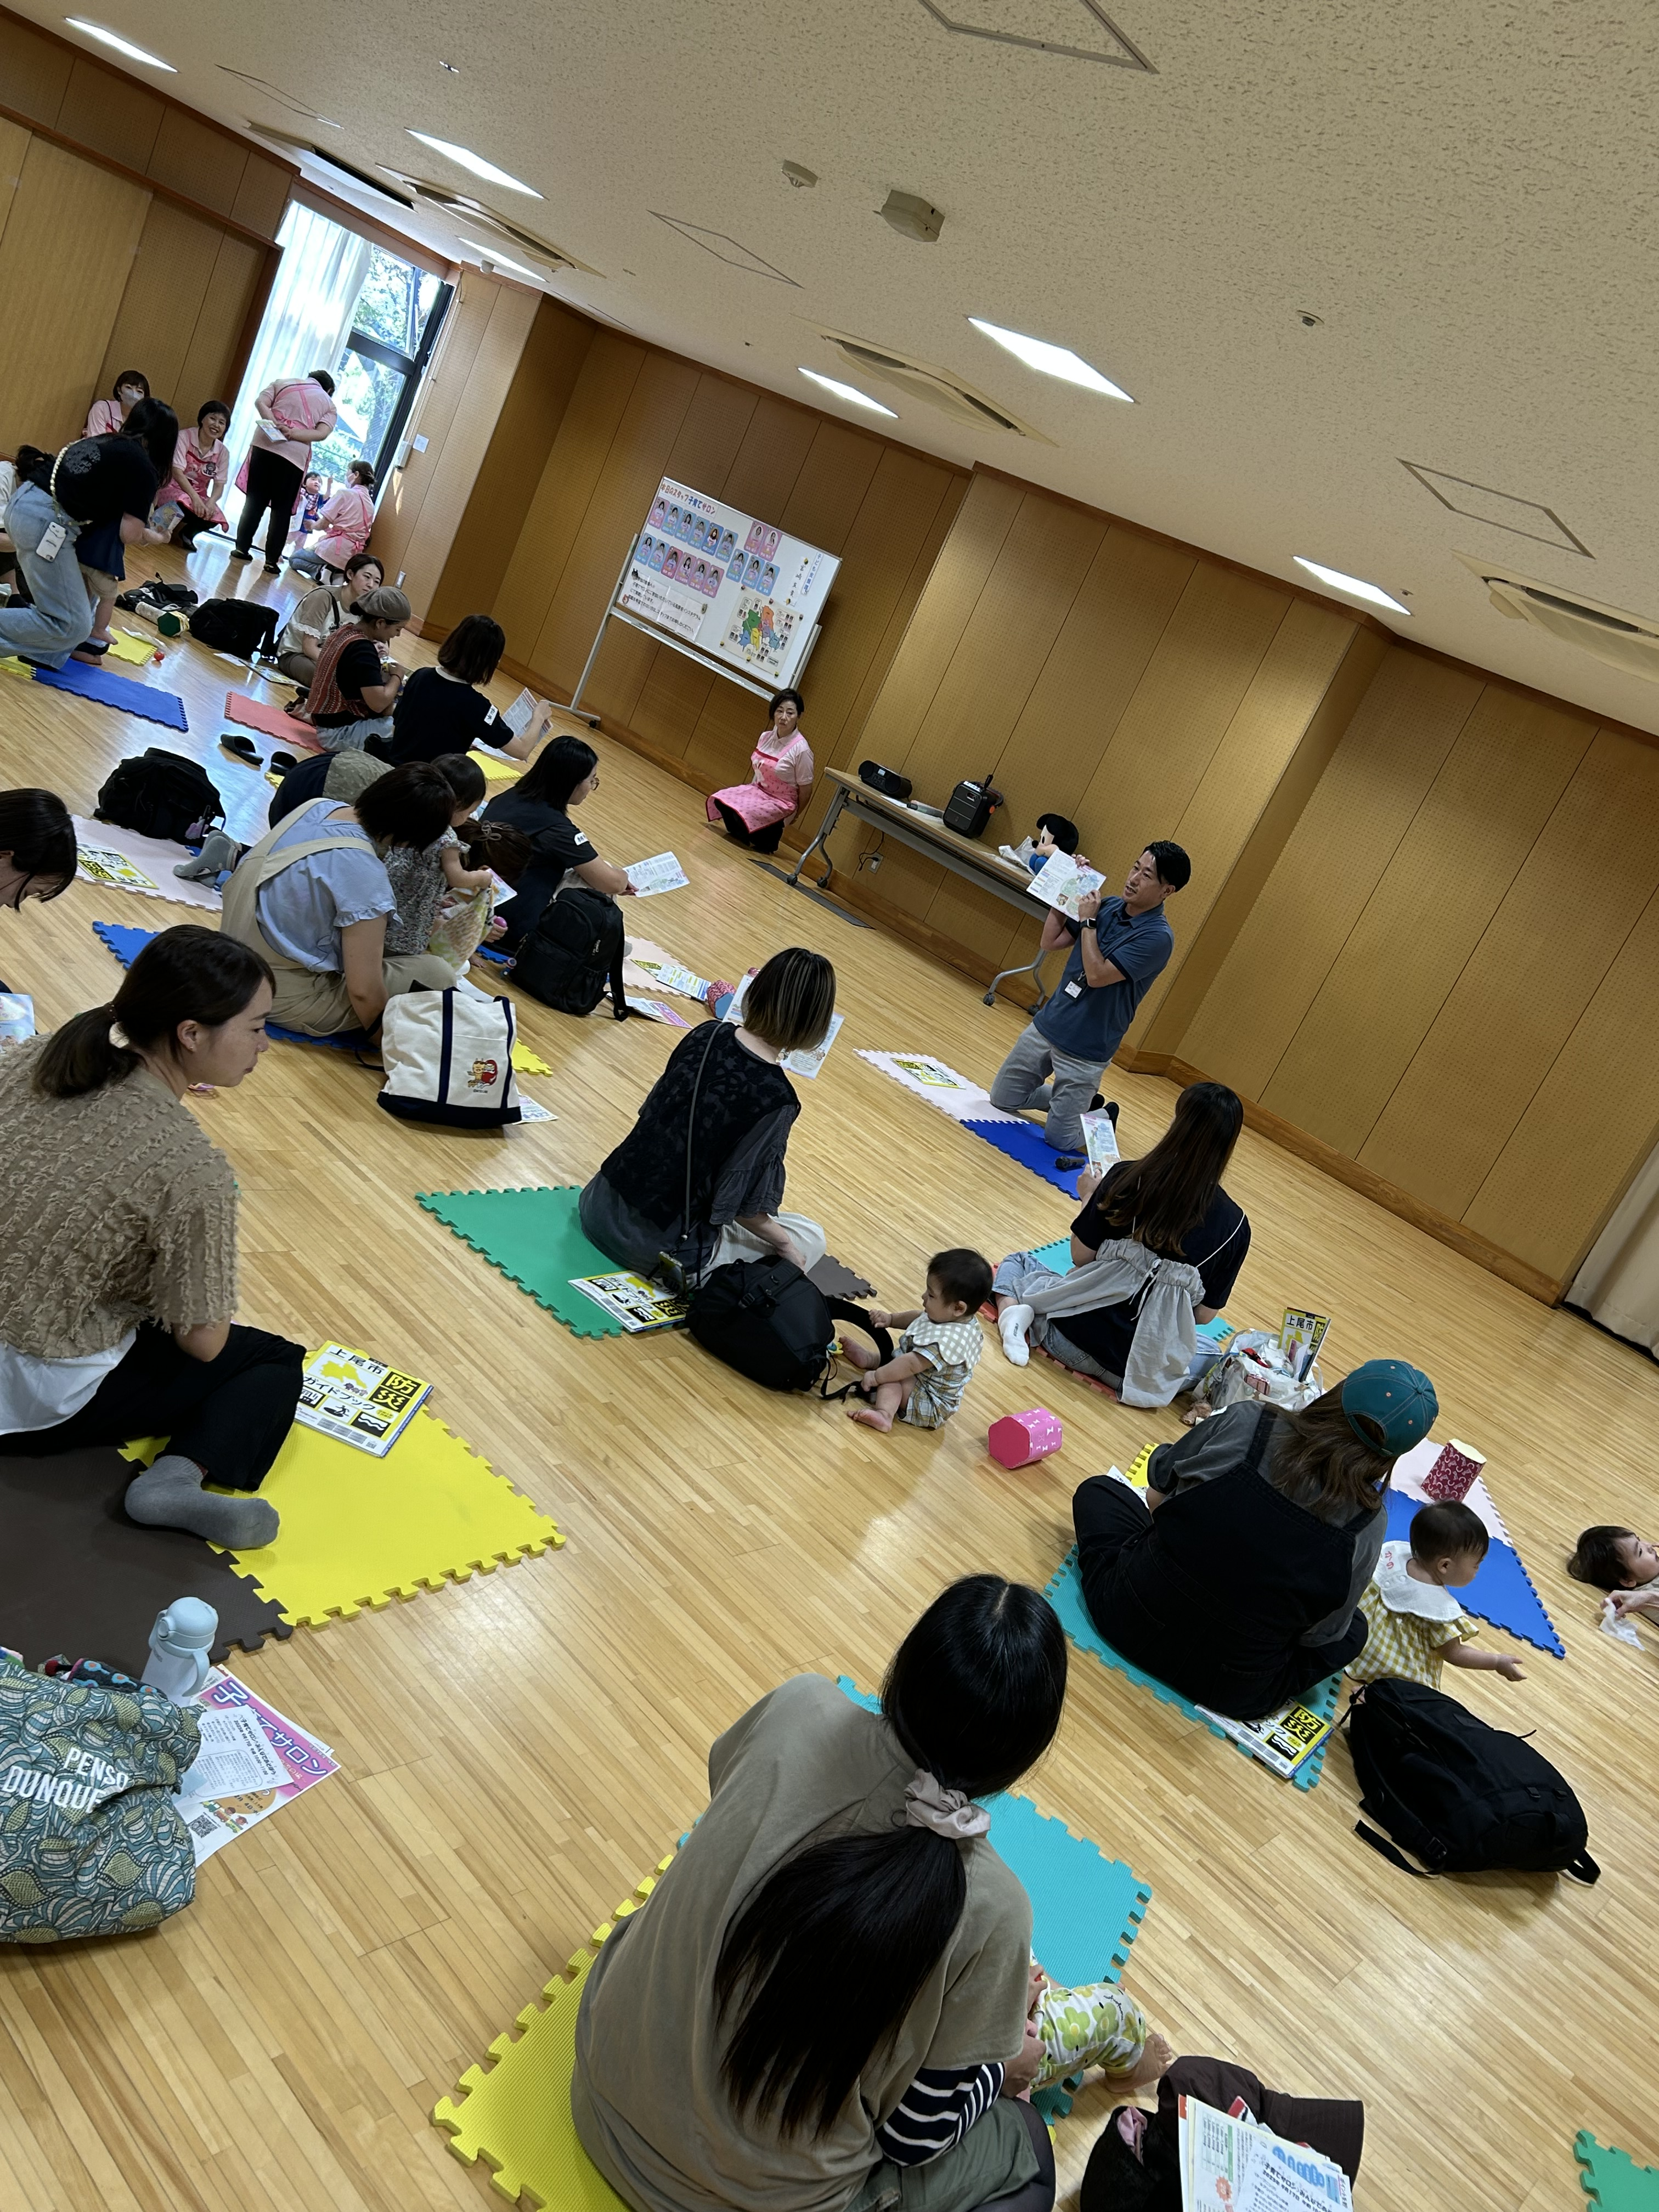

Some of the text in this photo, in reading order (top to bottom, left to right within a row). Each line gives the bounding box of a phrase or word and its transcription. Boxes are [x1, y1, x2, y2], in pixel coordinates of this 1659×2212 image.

[687, 496, 716, 515] 子育てサロン
[607, 1277, 653, 1308] ガイドブック
[1286, 1315, 1313, 1330] 上尾市
[303, 1376, 375, 1412] ガイドブック
[330, 1348, 418, 1411] 上尾市 防災
[213, 1681, 327, 1773] 子てサロン
[1283, 1708, 1321, 1741] 防災
[64, 1747, 128, 1791] PENSO
[1281, 2184, 1300, 2200] 9月17日
